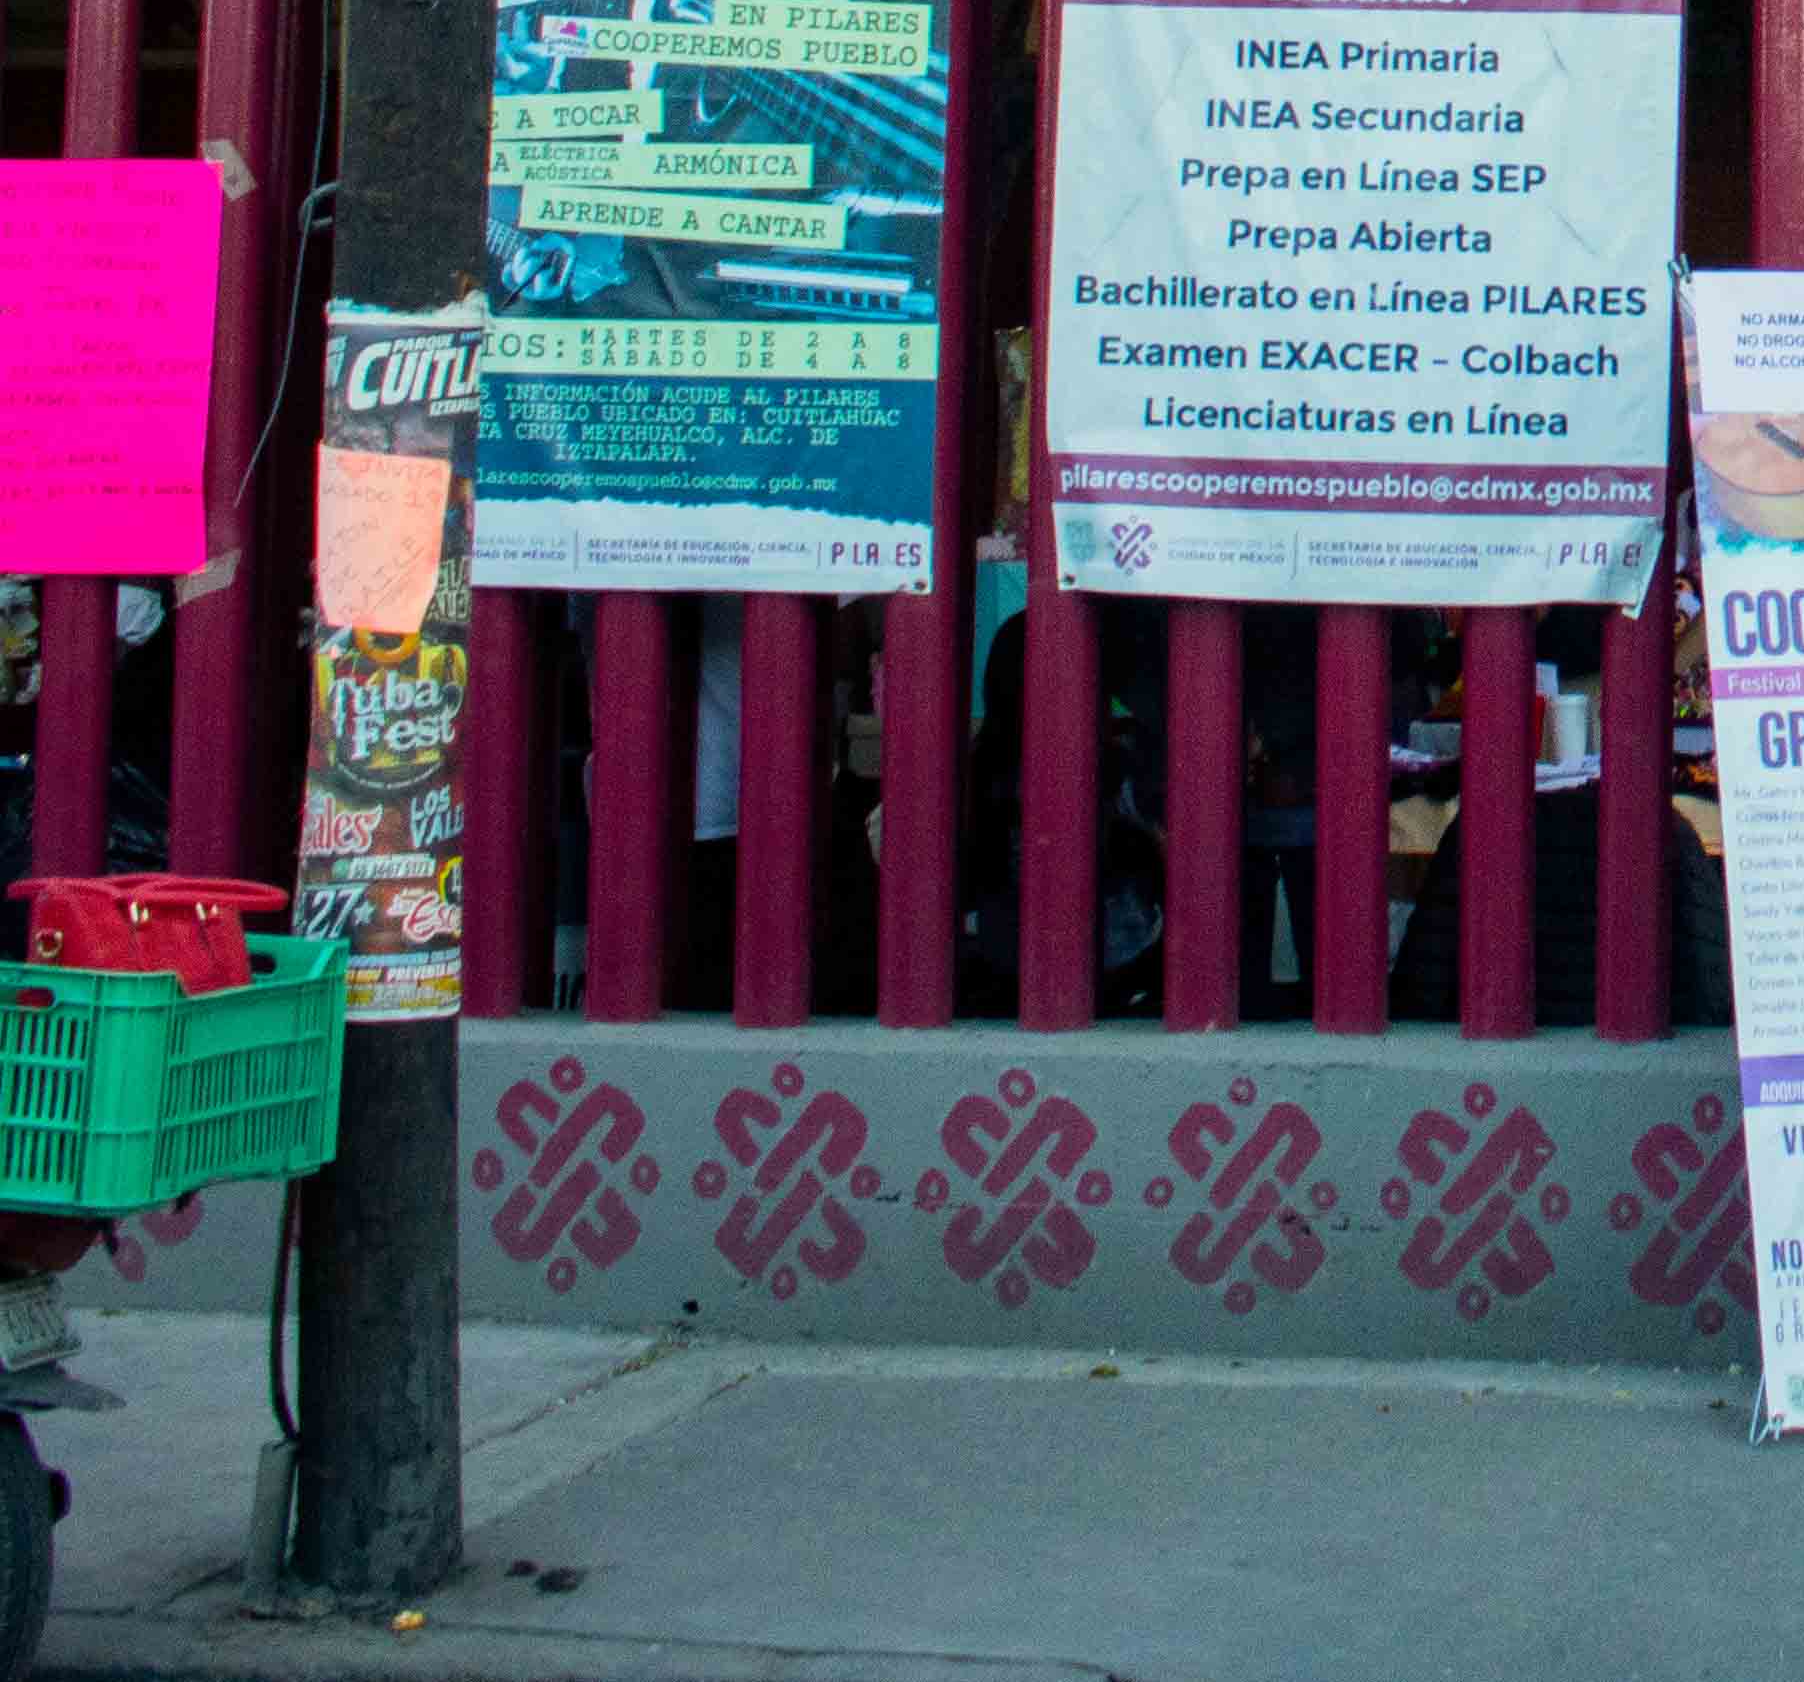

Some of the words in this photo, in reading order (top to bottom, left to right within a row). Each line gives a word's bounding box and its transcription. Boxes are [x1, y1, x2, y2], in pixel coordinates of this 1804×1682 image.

[730, 6, 765, 25] EN
[786, 6, 920, 35] PILARES
[593, 28, 782, 60] COOPEREMOS
[804, 43, 918, 66] PUEBLO
[1237, 40, 1329, 69] INEA
[1341, 40, 1499, 73] Primaria
[515, 109, 535, 130] A
[553, 103, 641, 128] TOCAR
[1207, 99, 1300, 129] INEA
[1311, 101, 1525, 134] Secundaria
[520, 141, 619, 162] ELÉCTRICA
[653, 147, 799, 177] ARMÓNICA
[523, 162, 614, 182] ACÚSTICA
[1181, 158, 1291, 196] Prepa
[1301, 167, 1346, 191] en
[1360, 159, 1459, 193] Línea
[1471, 163, 1547, 193] SEP
[538, 199, 664, 229] APRENDE
[681, 209, 700, 231] A
[719, 212, 826, 239] CANTAR
[1228, 219, 1338, 257] Prepa
[1349, 220, 1492, 253] Abierta
[1076, 274, 1299, 310] Bachillerato
[1309, 288, 1356, 311] en
[1369, 280, 1470, 314] Línea
[1483, 285, 1647, 316] PILARES
[1741, 313, 1762, 327] NO
[580, 327, 707, 347] MARTES
[738, 330, 776, 348] DE
[806, 332, 818, 348] 2
[853, 333, 865, 349] A
[898, 332, 911, 349] 8
[1737, 334, 1756, 348] NO
[580, 348, 707, 367] SÁBADO
[737, 353, 775, 367] DE
[806, 352, 817, 369] 4
[853, 353, 865, 368] A
[898, 352, 910, 371] 8
[1099, 335, 1247, 369] Examen
[1261, 340, 1419, 373] EXACER
[1462, 344, 1619, 377] Colbach
[1734, 355, 1756, 368] NO
[503, 379, 650, 404] INFORMACIÓN
[661, 386, 731, 405] ACUDE
[743, 387, 772, 405] AL
[785, 388, 879, 407] PILARES
[510, 403, 589, 422] PUEBLO
[601, 404, 697, 424] UBICADO
[708, 406, 746, 424] EN:
[1144, 396, 1396, 433] Licenciaturas
[1407, 410, 1454, 434] en
[1467, 403, 1569, 436] Línea
[516, 424, 569, 442] CRUZ
[581, 423, 725, 447] MEYEHUALCO,
[742, 428, 793, 446] ALC.
[810, 427, 839, 446] DE
[555, 443, 697, 463] IZTAPALAPA.
[1060, 462, 1653, 507] pilarescooperemospueblo@cdmx.gob.mx
[1727, 670, 1802, 695] Festival
[328, 669, 444, 737] Tuba
[350, 705, 454, 761] Fest
